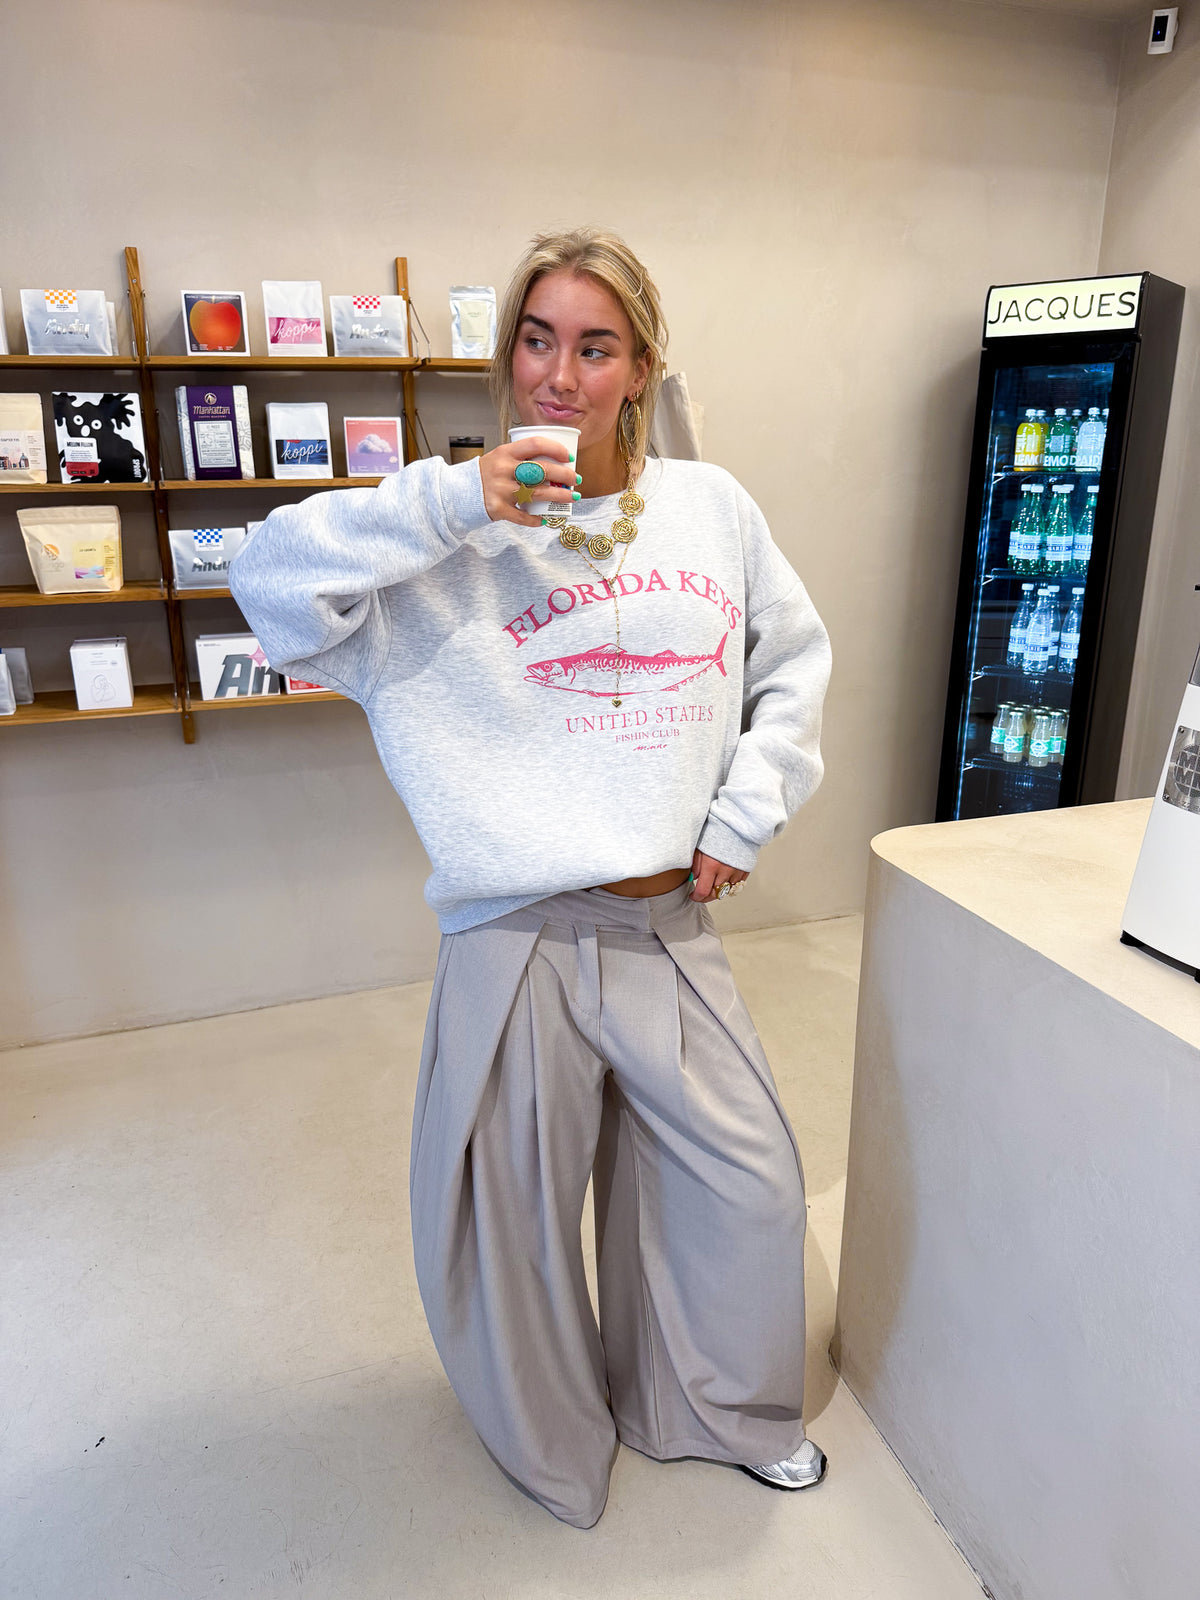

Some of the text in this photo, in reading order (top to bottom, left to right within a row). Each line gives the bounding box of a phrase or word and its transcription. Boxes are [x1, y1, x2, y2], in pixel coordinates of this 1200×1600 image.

[988, 291, 1136, 325] JACQUES
[273, 319, 318, 343] koppi
[281, 440, 324, 463] koppi
[501, 568, 742, 648] FLORIDA KEYS
[565, 705, 714, 734] UNITED STATES
[615, 728, 680, 743] FISHIN CLUB
